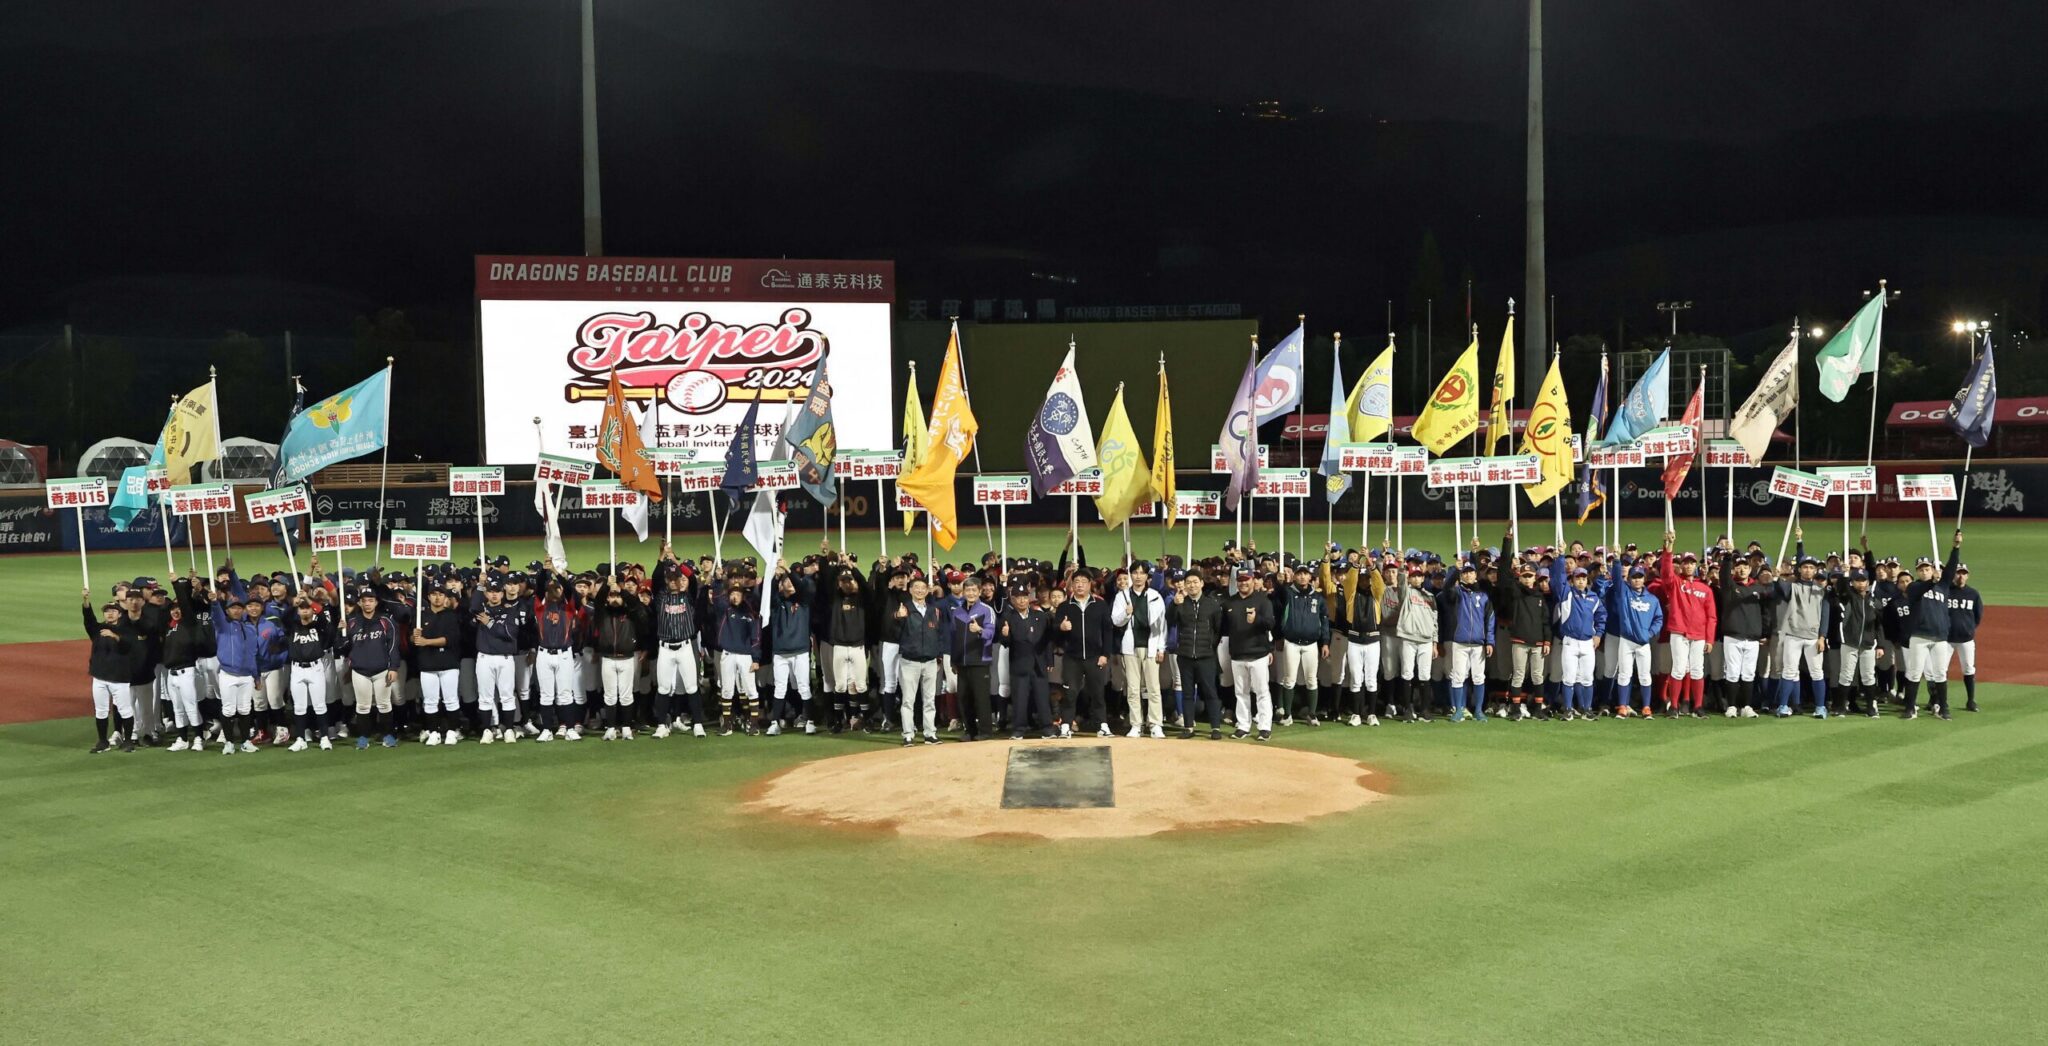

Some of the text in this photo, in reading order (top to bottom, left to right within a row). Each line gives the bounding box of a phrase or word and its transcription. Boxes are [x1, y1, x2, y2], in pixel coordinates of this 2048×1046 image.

[490, 263, 732, 282] DRAGONS BASEBALL CLUB
[797, 273, 883, 289] 通泰克科技
[1116, 304, 1182, 318] BASEBLL
[567, 308, 828, 372] Taipei
[743, 367, 814, 388] 2024
[1591, 452, 1642, 465] 桃園新明
[1431, 470, 1481, 485] 臺中中山
[1487, 467, 1537, 481] 新北二重
[453, 480, 502, 493] 韓國首爾
[684, 474, 721, 489] 竹市虎
[747, 473, 798, 490] 本北九州
[1256, 481, 1307, 494] 臺北興福
[1832, 479, 1872, 492] 園仁和
[51, 491, 106, 505] 香港U15
[977, 489, 1028, 502] 日本宮崎
[1773, 479, 1825, 503] 花蓮三民
[175, 496, 231, 513] 臺南崇明
[585, 492, 637, 506] 新北新泰
[252, 498, 307, 519] 日本大阪
[1176, 503, 1217, 516] 北大理
